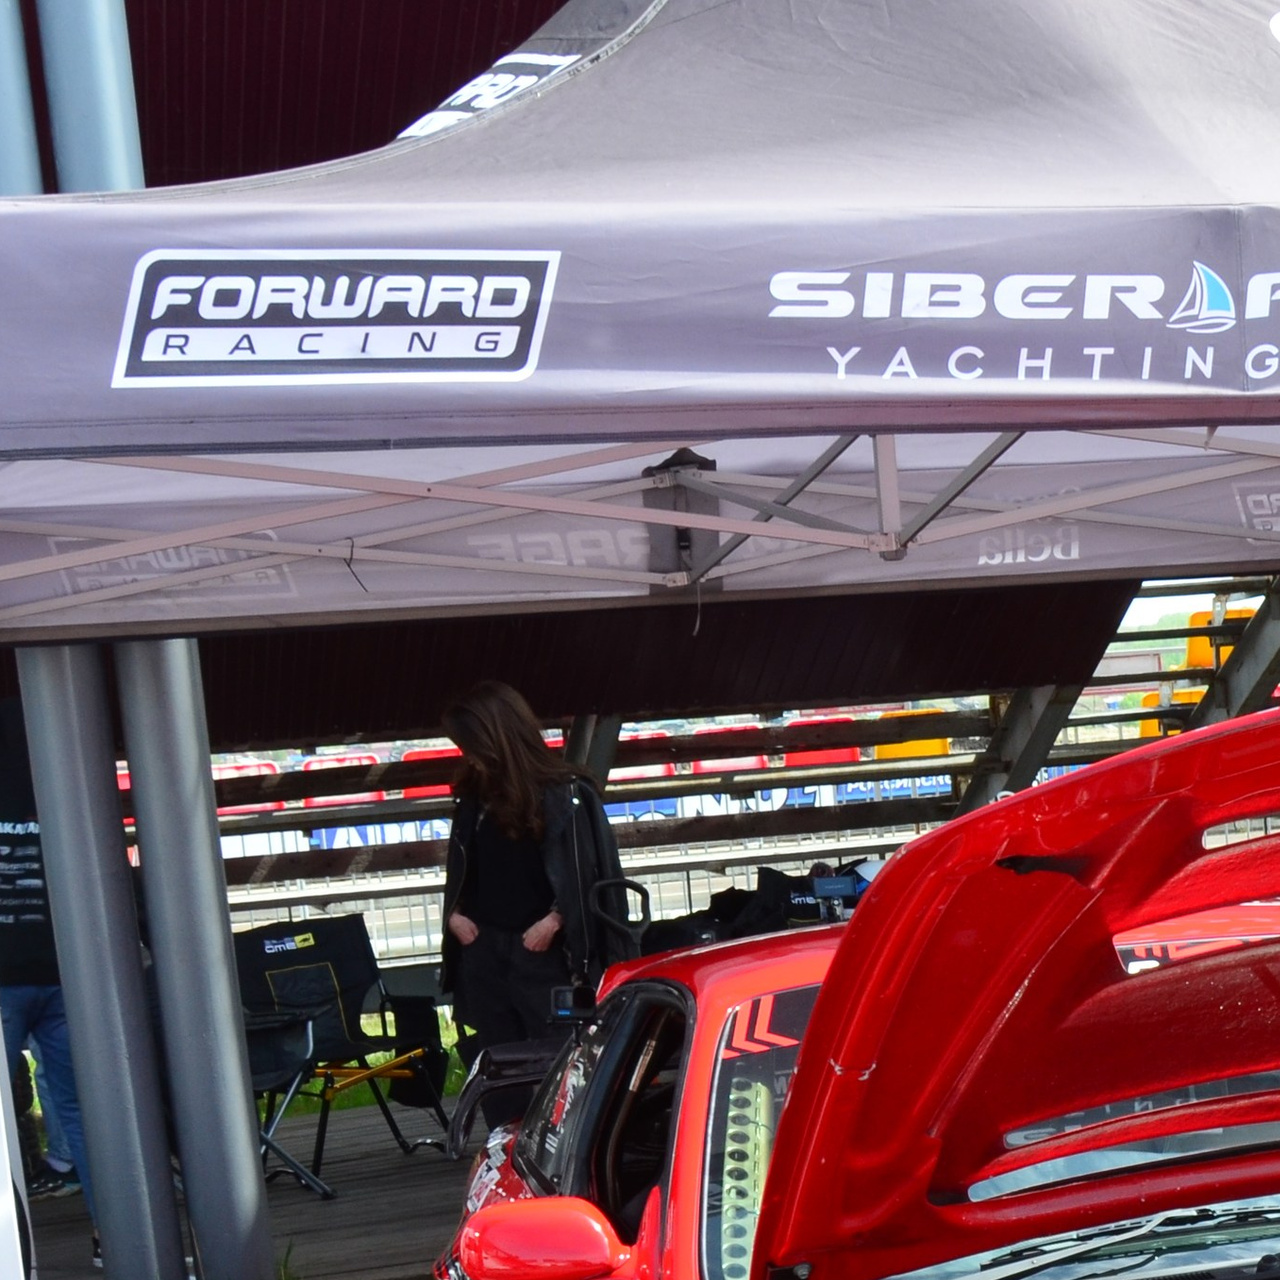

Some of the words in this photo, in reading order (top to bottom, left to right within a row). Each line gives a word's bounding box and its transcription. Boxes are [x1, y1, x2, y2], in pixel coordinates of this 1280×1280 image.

[151, 275, 531, 319] FORWARD
[162, 331, 500, 356] RACING
[826, 343, 1280, 380] YACHTING
